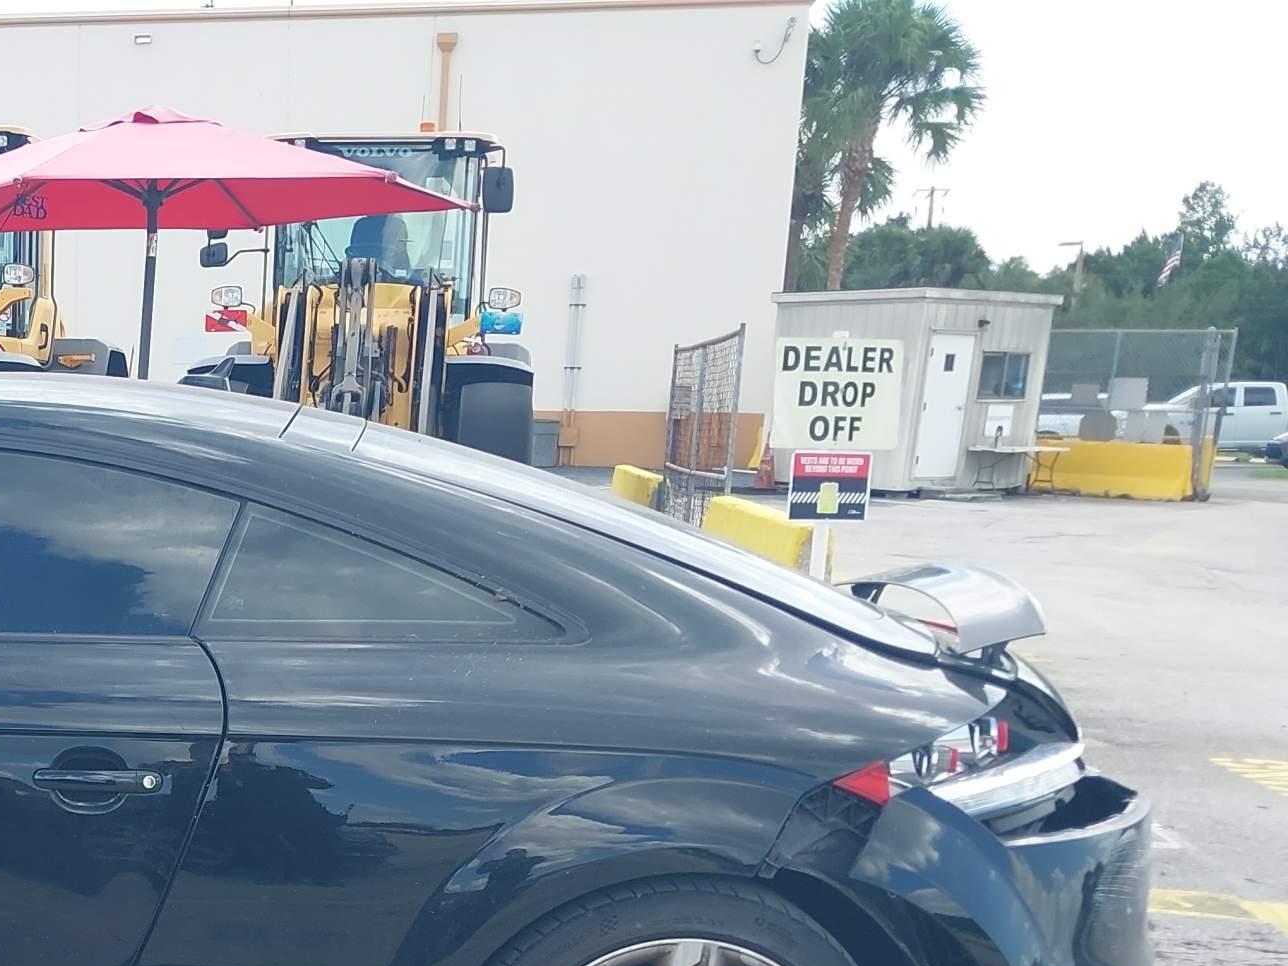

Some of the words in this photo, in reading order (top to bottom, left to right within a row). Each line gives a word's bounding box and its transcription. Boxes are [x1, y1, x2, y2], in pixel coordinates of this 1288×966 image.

[339, 147, 412, 157] VOLVO
[782, 346, 894, 373] DEALER
[798, 381, 875, 407] DROP
[809, 416, 862, 442] OFF
